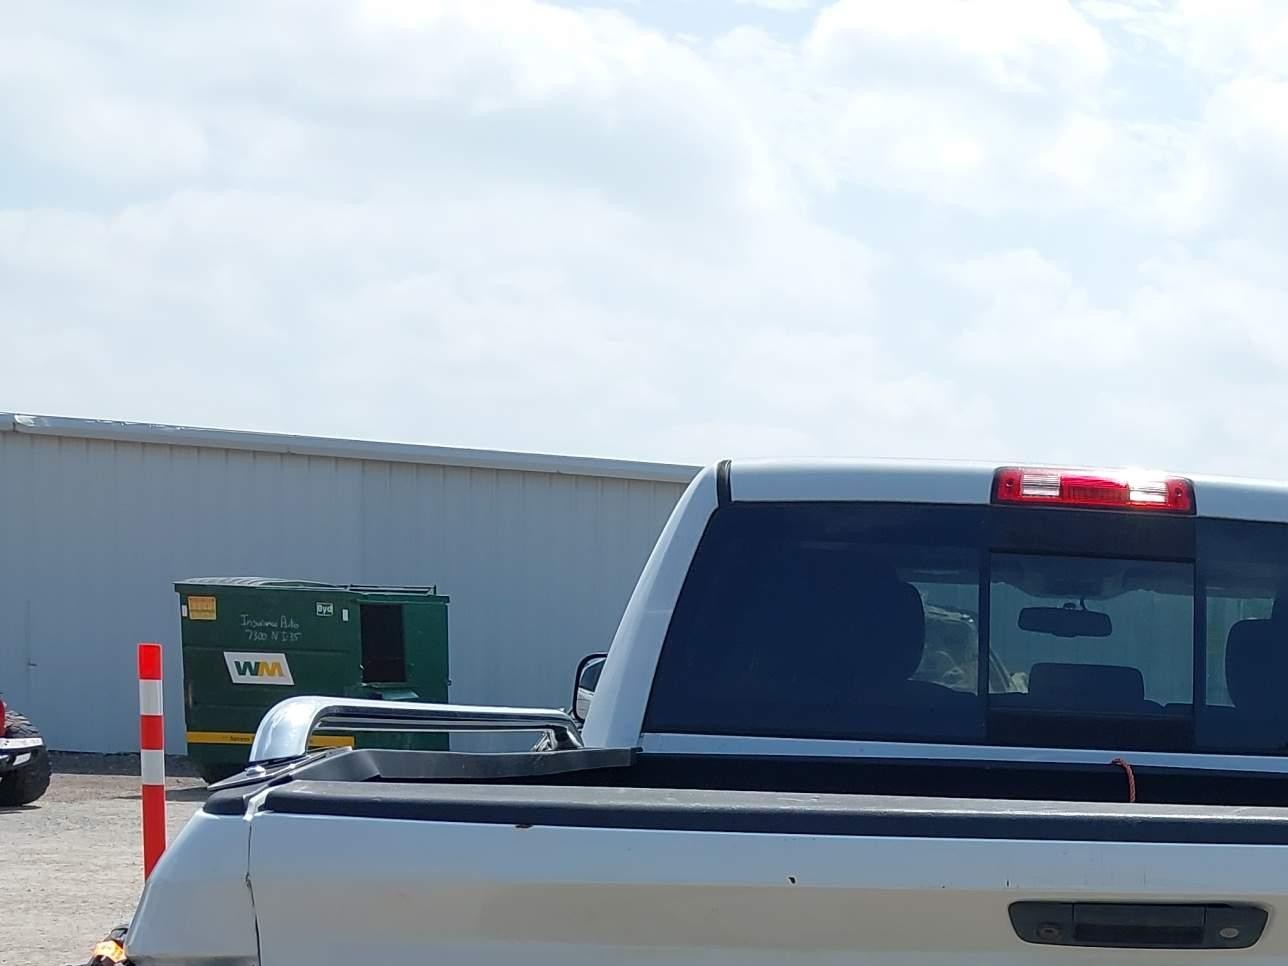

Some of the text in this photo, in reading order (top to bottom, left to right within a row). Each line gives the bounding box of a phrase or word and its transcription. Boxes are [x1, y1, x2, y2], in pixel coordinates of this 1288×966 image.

[280, 616, 300, 629] Auto
[245, 629, 268, 641] 7300
[271, 631, 279, 641] N
[234, 661, 283, 676] WM
